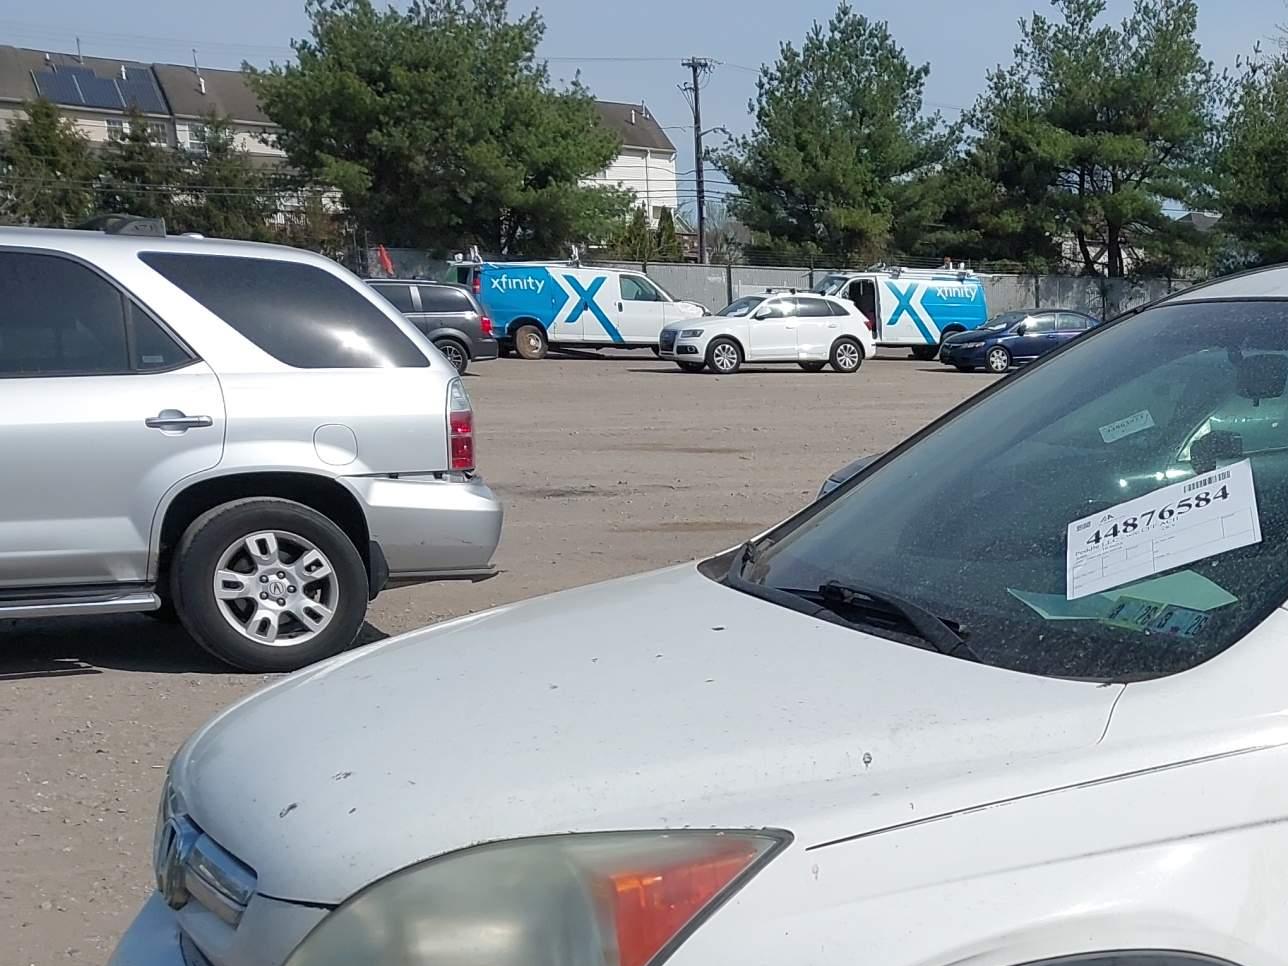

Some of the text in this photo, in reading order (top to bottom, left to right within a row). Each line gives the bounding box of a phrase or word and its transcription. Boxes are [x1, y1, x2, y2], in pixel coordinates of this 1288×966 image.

[491, 274, 545, 294] xfinity
[936, 286, 978, 302] xfinity
[1086, 484, 1230, 546] 44876584
